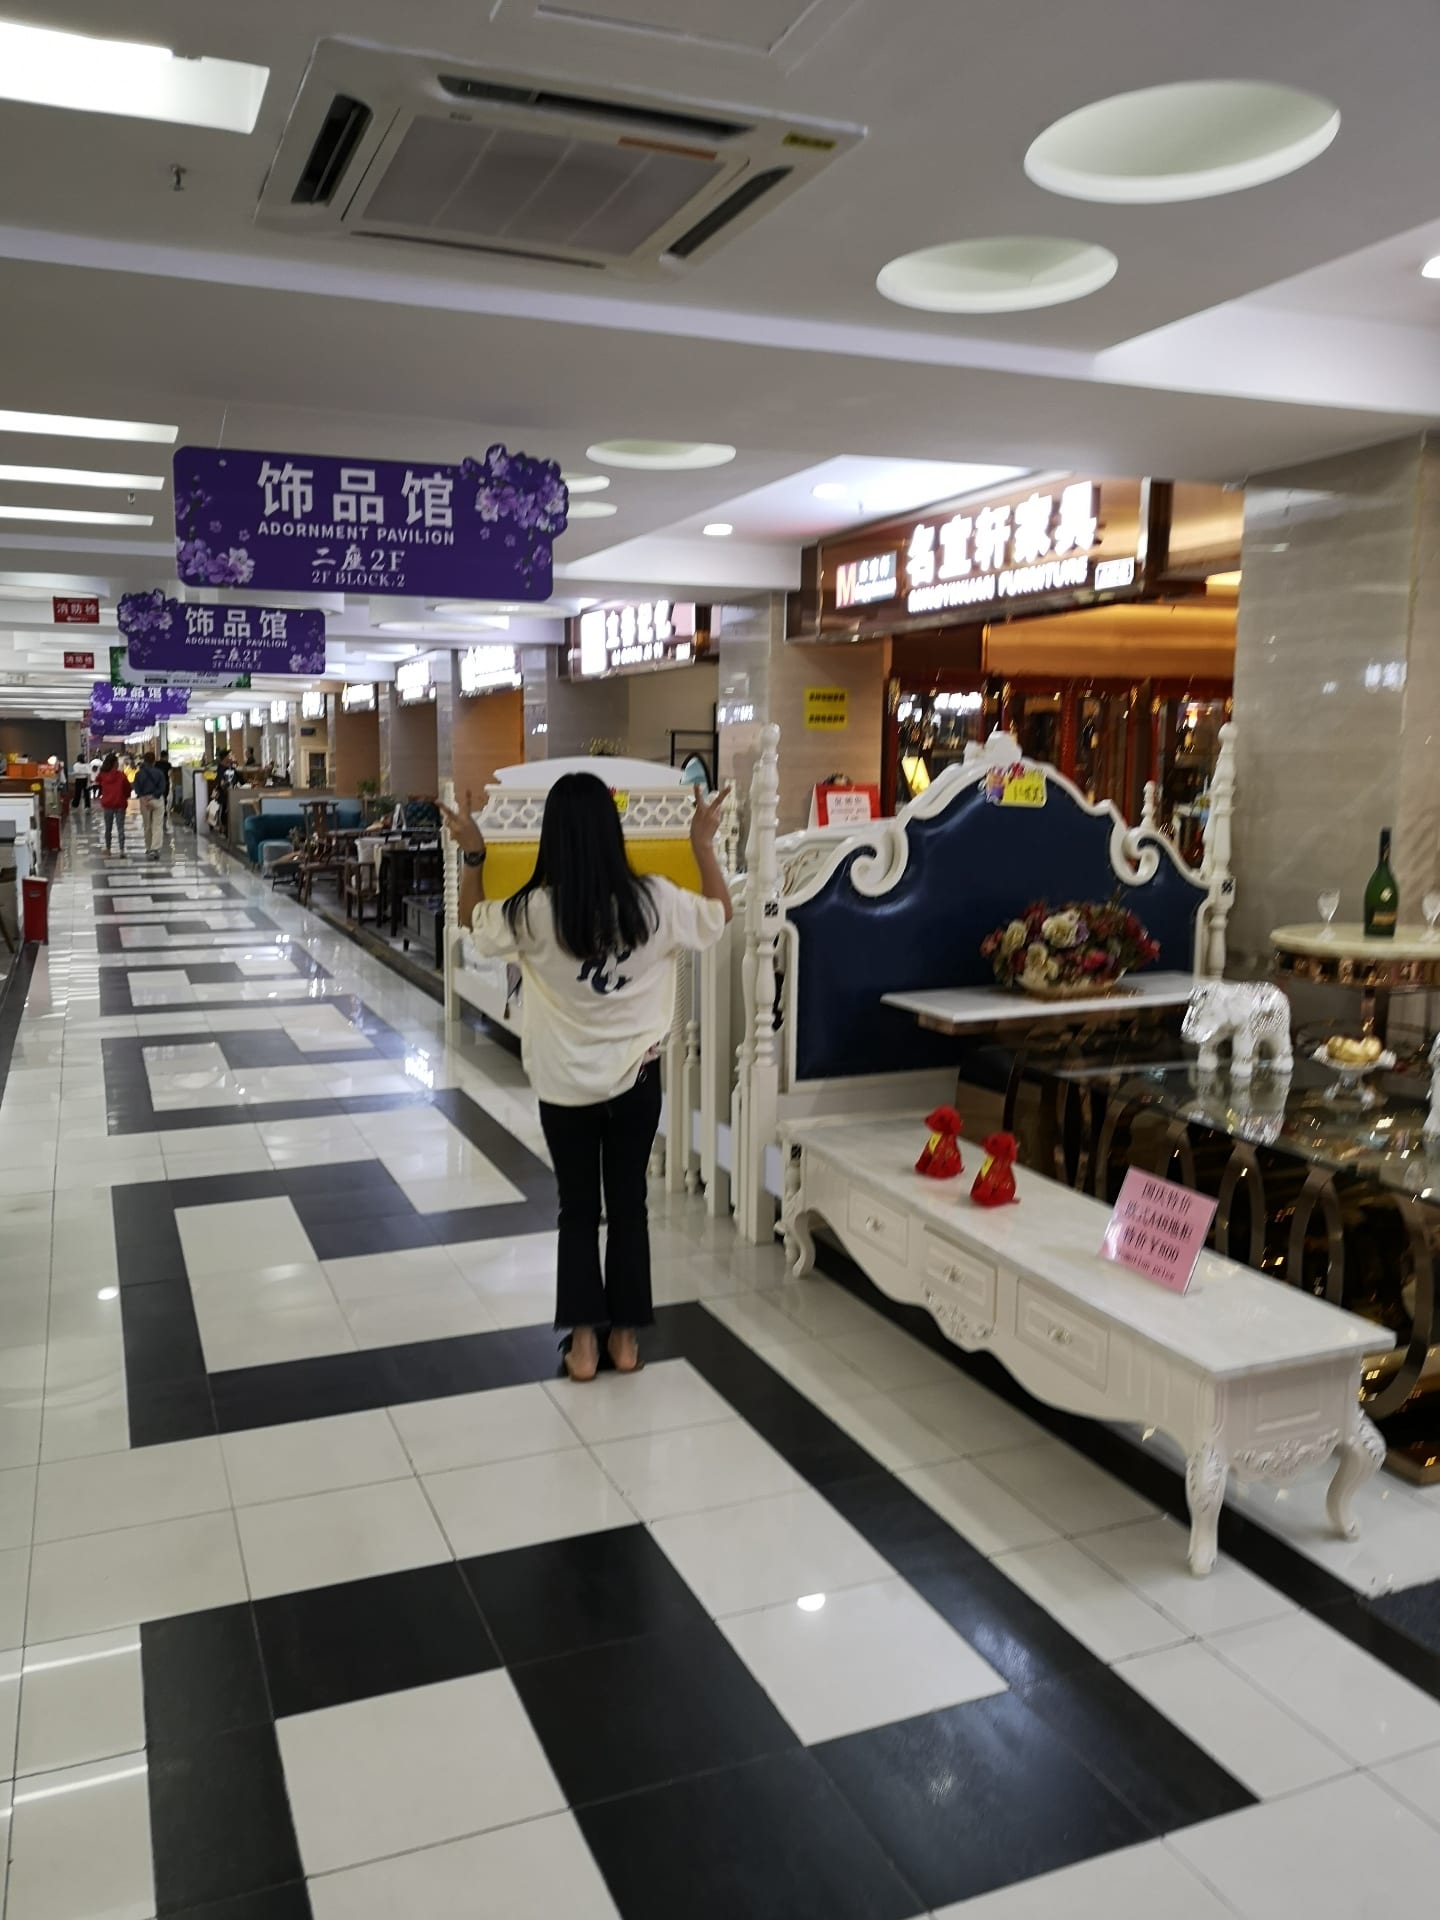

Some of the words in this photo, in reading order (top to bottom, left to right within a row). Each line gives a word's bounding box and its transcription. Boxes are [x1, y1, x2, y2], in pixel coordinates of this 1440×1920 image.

[257, 460, 454, 529] 饰品馆
[257, 520, 369, 541] ADORNMENT
[377, 526, 454, 546] PAVILION
[311, 570, 331, 584] 2F
[56, 602, 98, 616] 消防栓
[184, 606, 288, 640] 饰品馆
[184, 636, 243, 647] ADORNMENT
[246, 638, 288, 649] PAVILION
